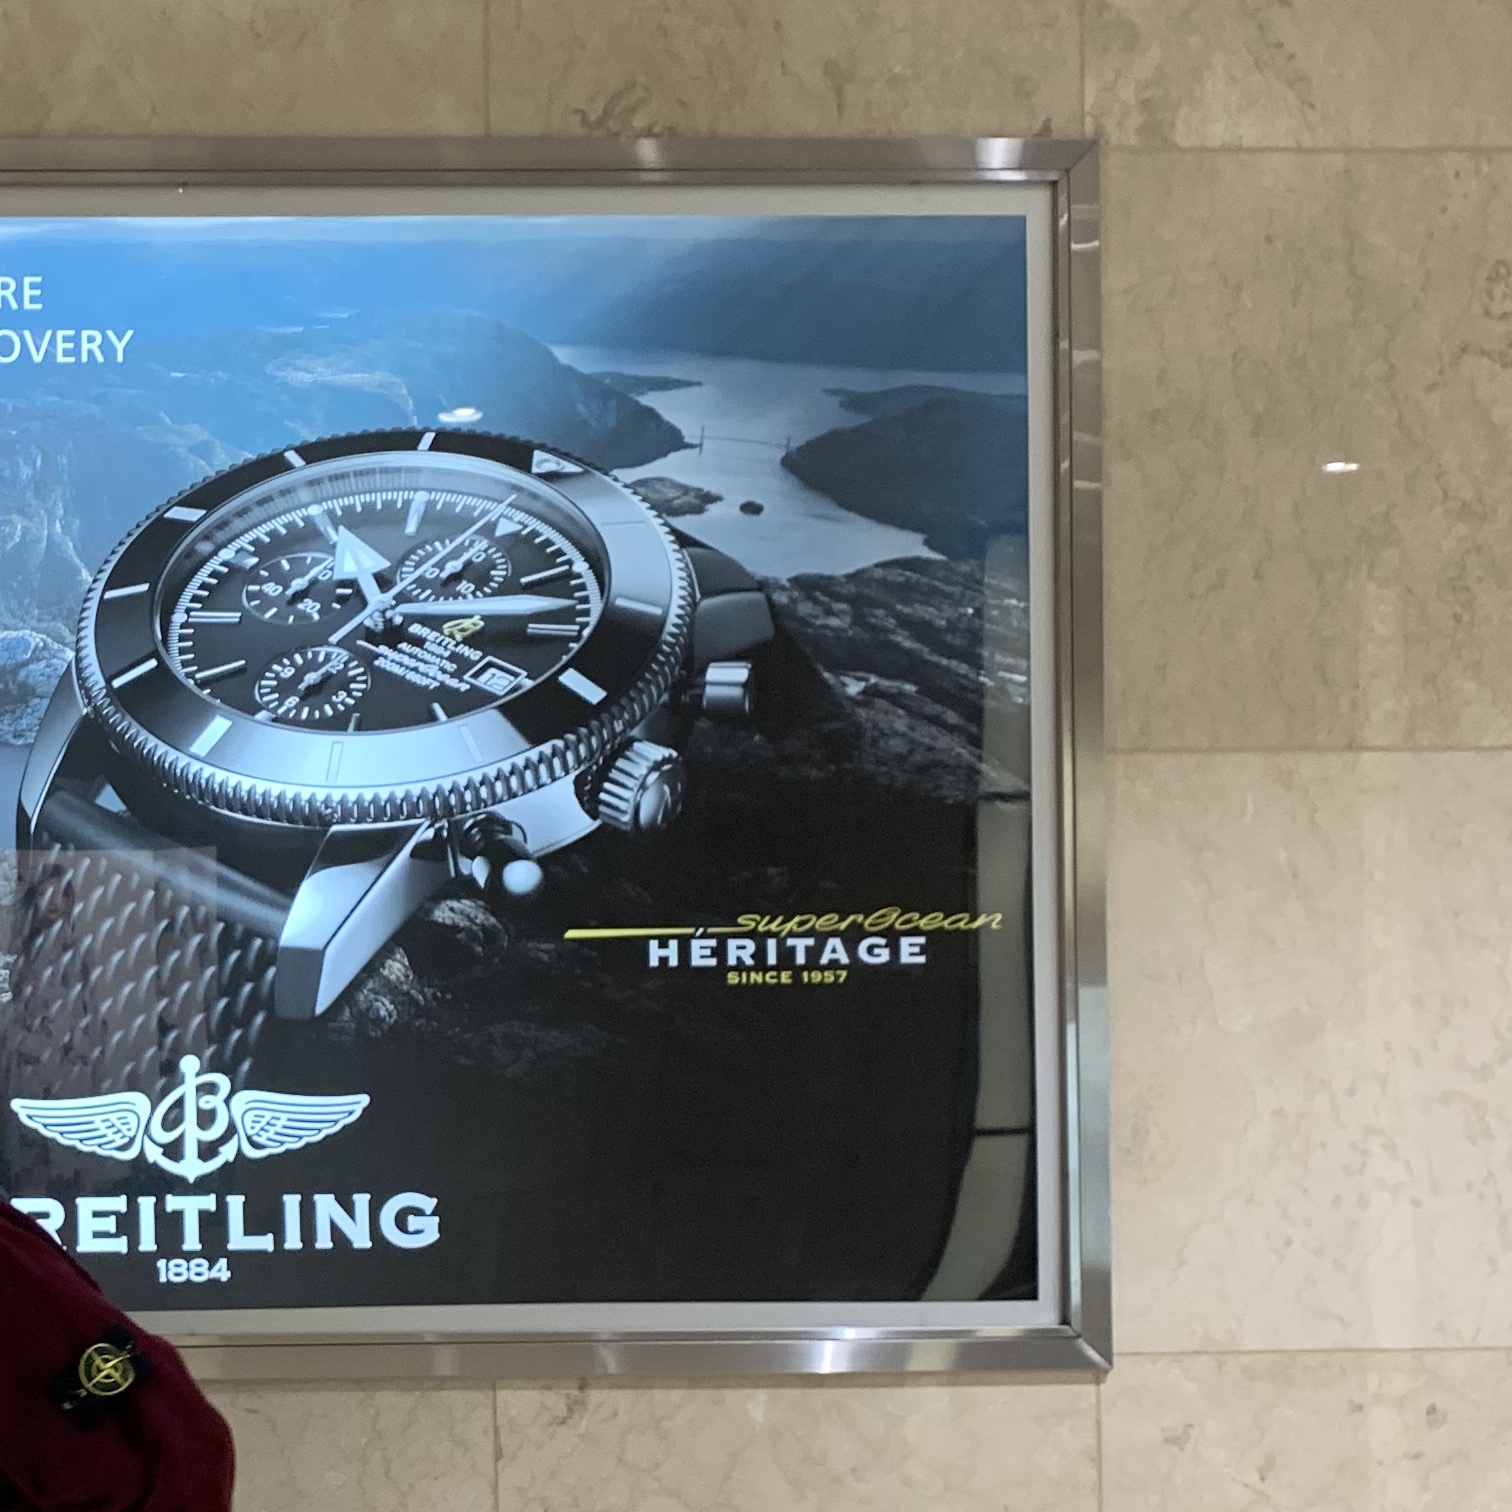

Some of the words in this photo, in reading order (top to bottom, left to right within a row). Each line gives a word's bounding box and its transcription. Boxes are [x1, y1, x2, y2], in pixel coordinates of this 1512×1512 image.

[261, 582, 283, 596] 40
[455, 580, 475, 594] 10
[297, 598, 321, 613] 20
[408, 623, 483, 661] BREITLING
[397, 642, 457, 673] AUTOMATIC
[648, 927, 927, 967] HÉRITAGE
[727, 970, 793, 985] SINCE
[802, 970, 848, 985] 1957
[10, 1192, 440, 1253] REITLING
[156, 1257, 231, 1284] 1884
